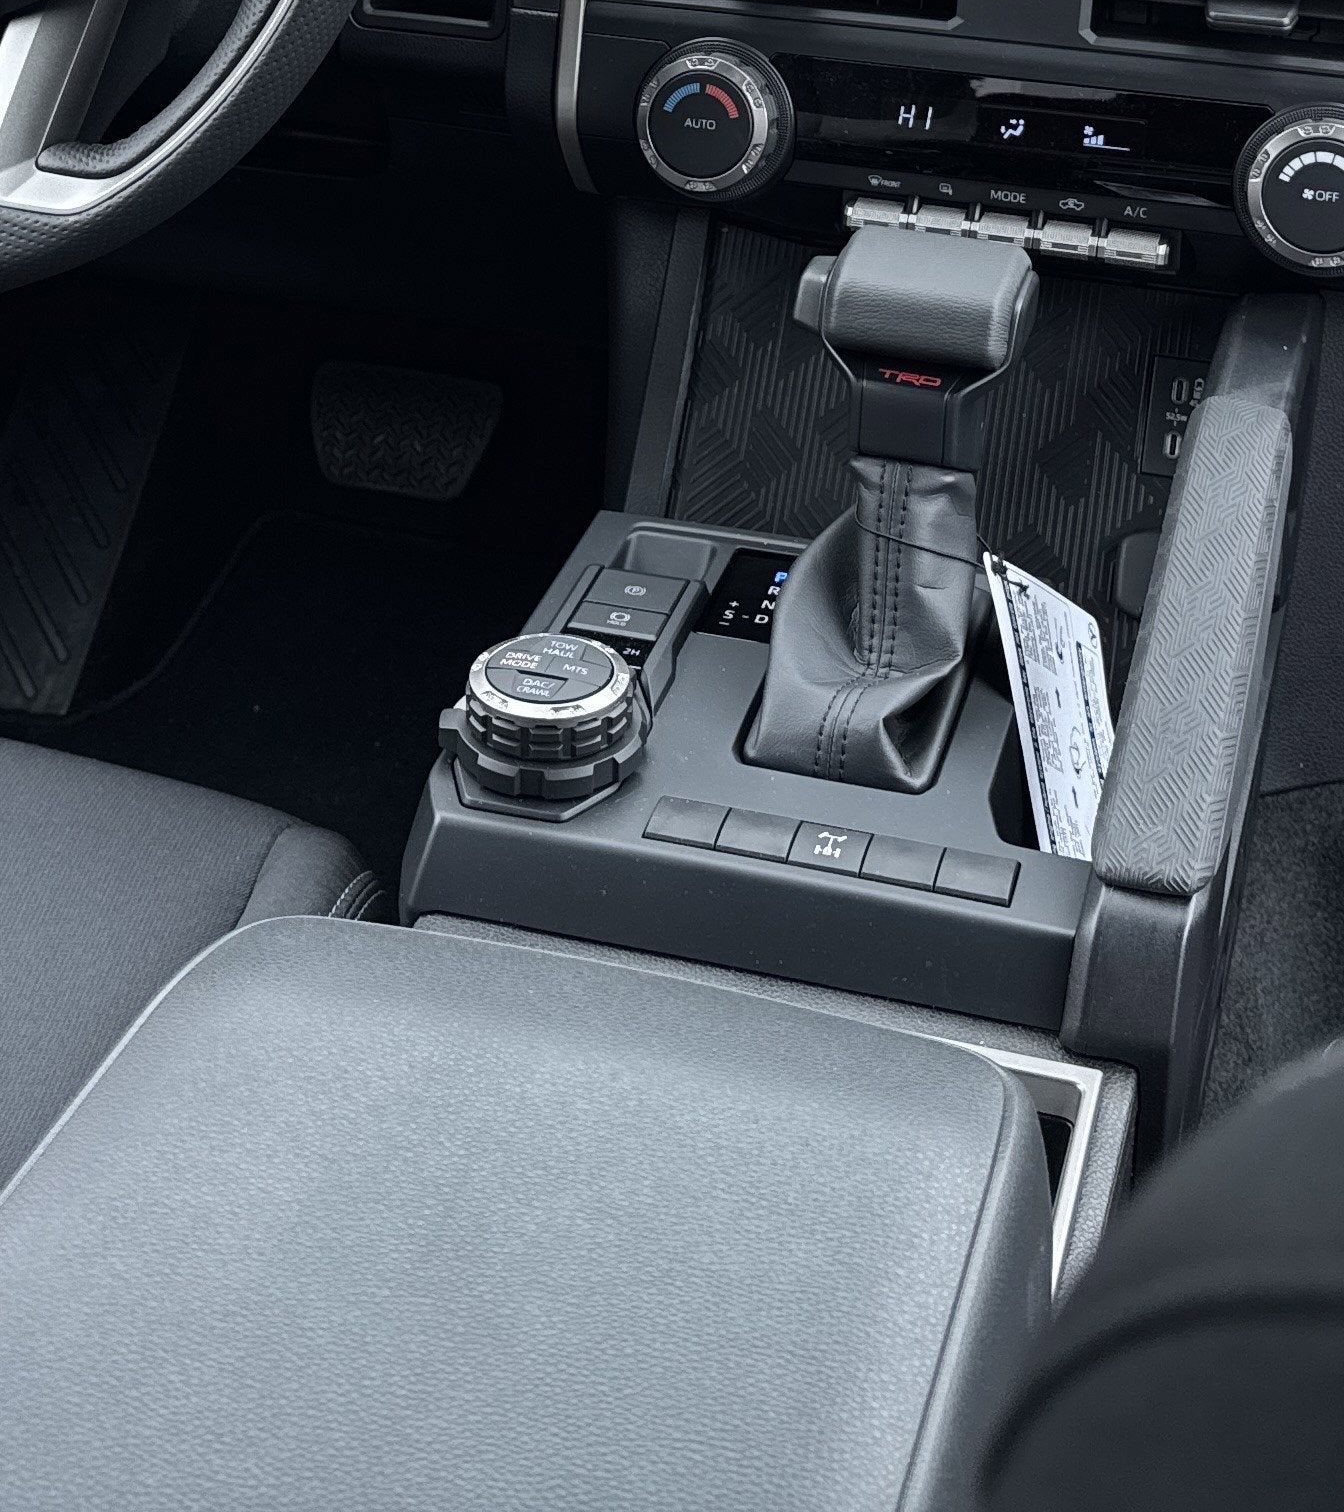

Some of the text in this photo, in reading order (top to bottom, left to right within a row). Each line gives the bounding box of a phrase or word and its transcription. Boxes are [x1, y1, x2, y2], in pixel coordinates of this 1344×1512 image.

[684, 117, 716, 131] AUTO
[990, 189, 1027, 204] MODE
[1316, 190, 1340, 203] OFF
[1123, 206, 1148, 219] A/C
[878, 368, 942, 387] TRD
[774, 571, 788, 583] P
[768, 585, 780, 596] R
[761, 599, 775, 610] N
[722, 609, 769, 624] S D
[550, 640, 578, 652] TOW
[622, 647, 641, 656] 2H
[505, 651, 542, 662] DRIVE
[542, 647, 575, 659] HAUL
[499, 658, 539, 670] MODE
[562, 663, 589, 676] MTS
[522, 678, 556, 689] DAC/
[516, 686, 551, 698] CRAWL
